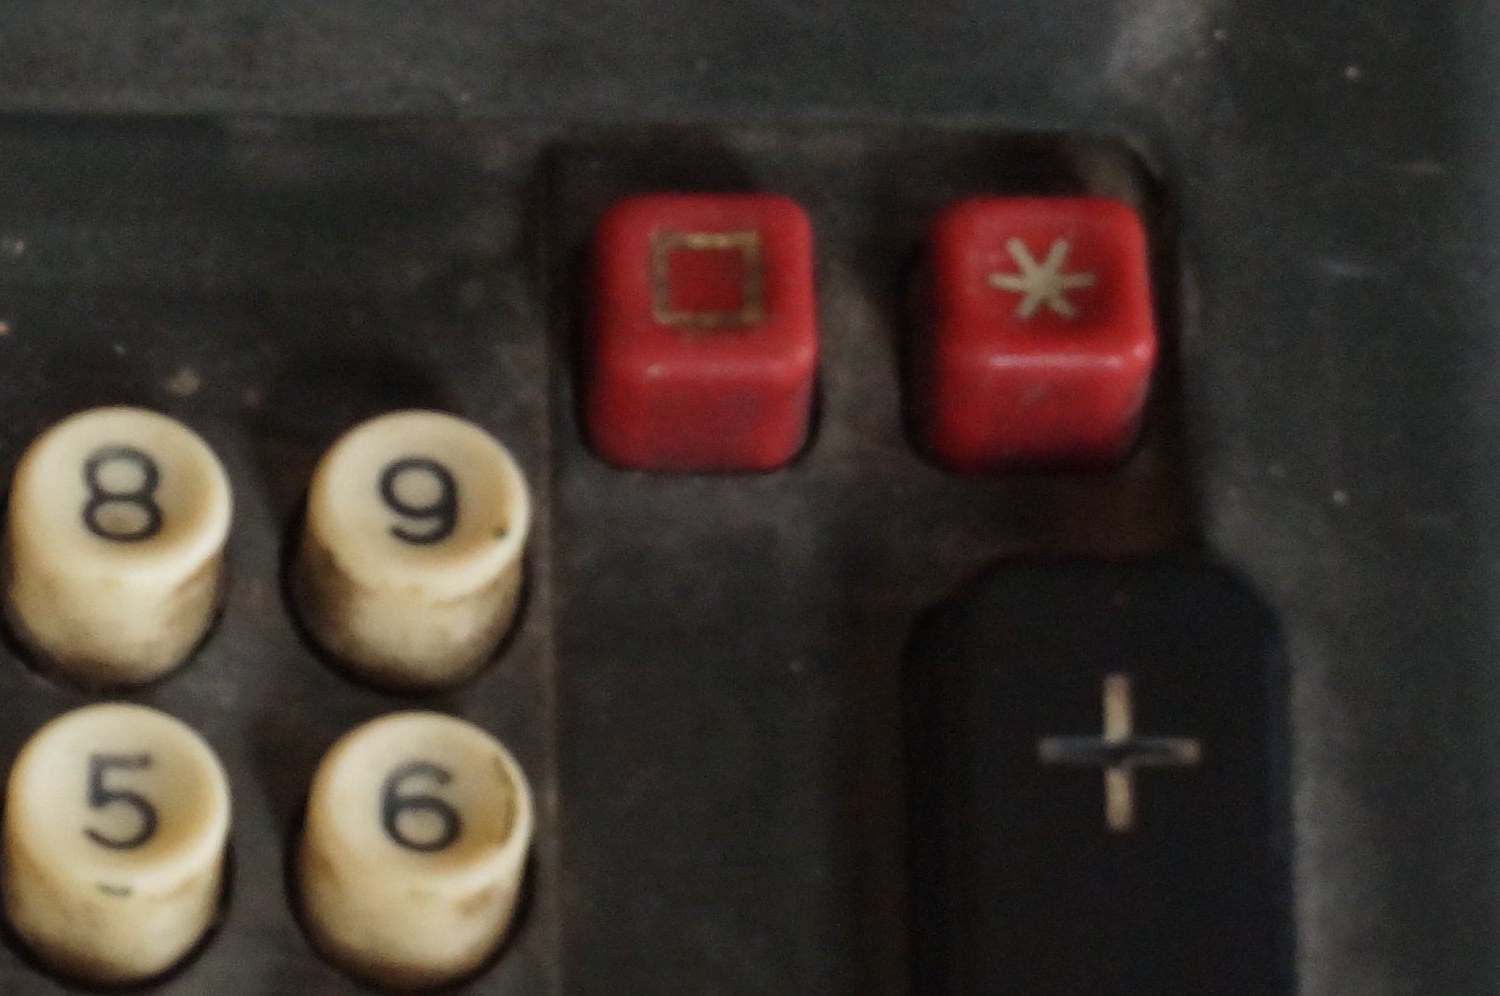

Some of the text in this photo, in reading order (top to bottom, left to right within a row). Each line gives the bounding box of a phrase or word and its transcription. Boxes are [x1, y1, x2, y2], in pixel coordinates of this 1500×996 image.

[81, 446, 164, 542] 8
[378, 457, 458, 545] 9
[82, 752, 159, 852] 5
[380, 760, 461, 854] 6
